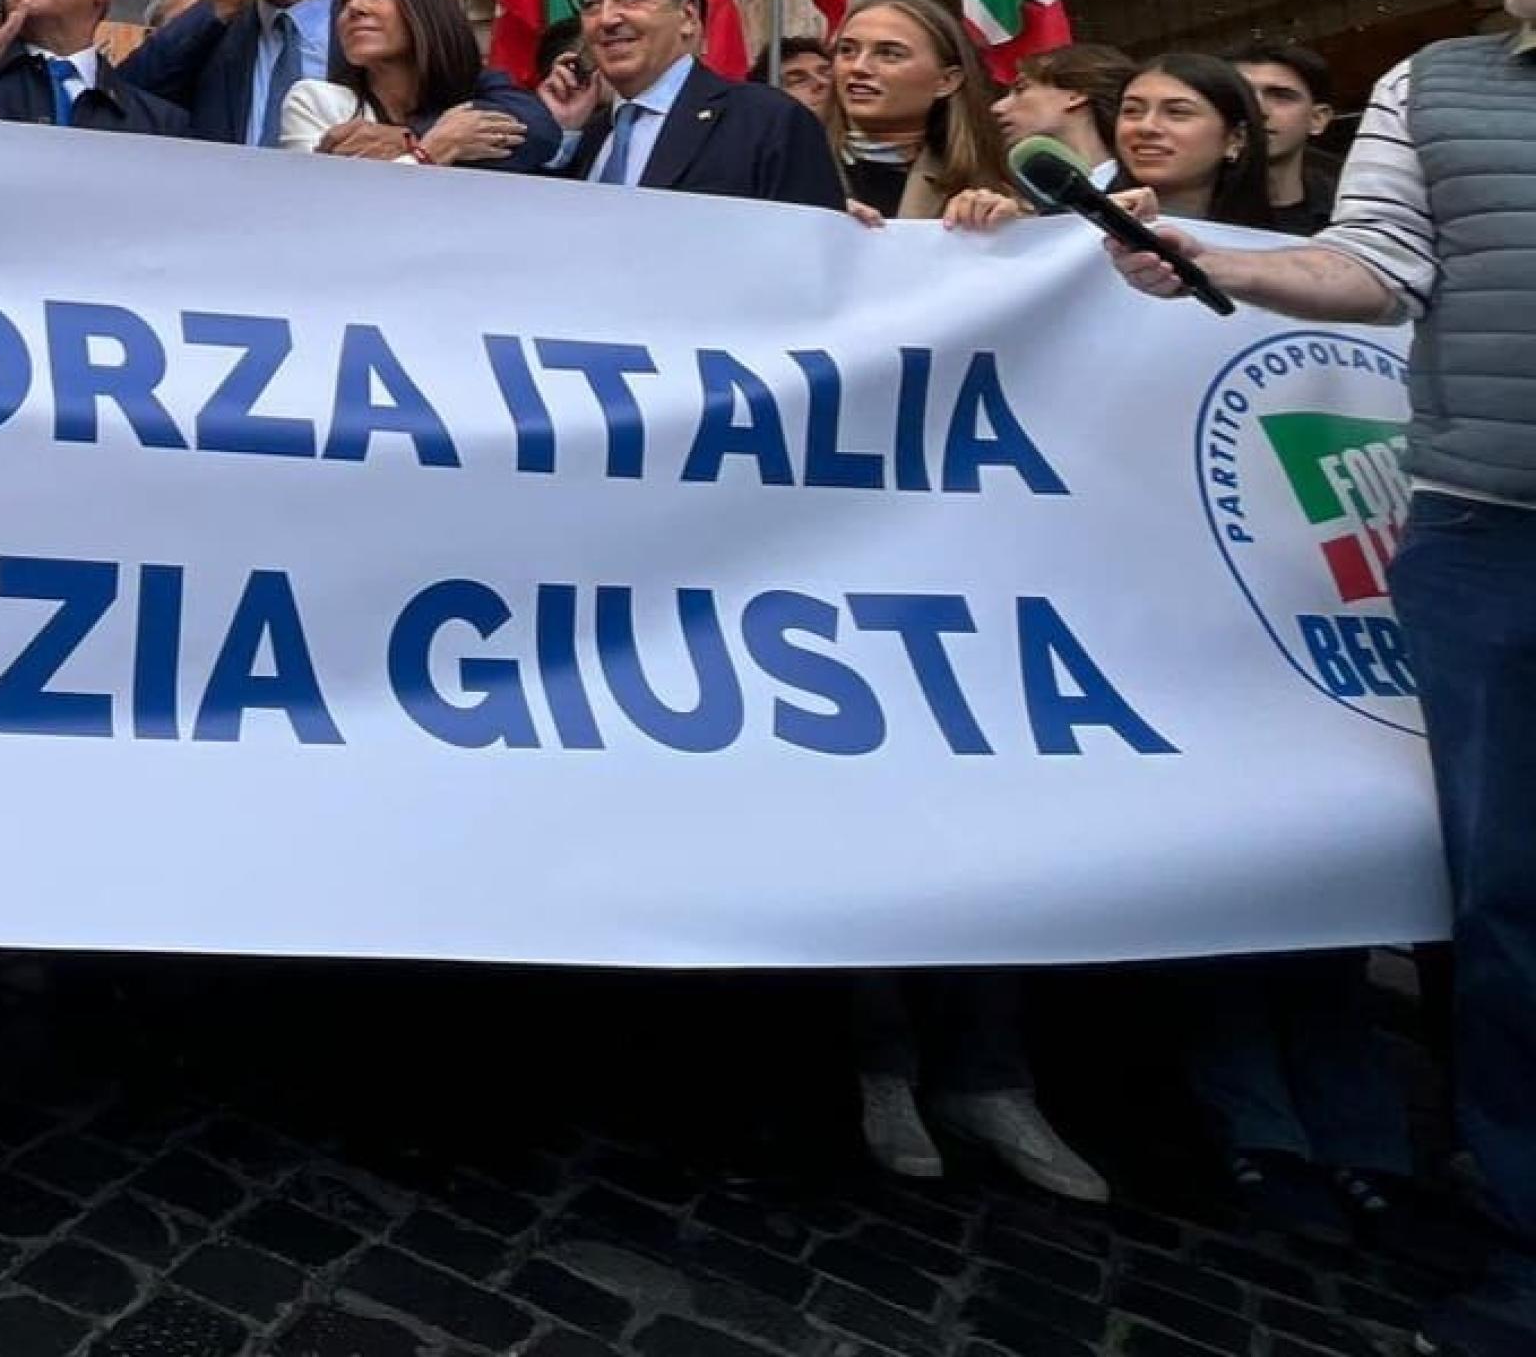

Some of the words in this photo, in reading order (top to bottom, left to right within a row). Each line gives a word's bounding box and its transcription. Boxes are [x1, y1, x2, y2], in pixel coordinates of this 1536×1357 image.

[488, 337, 1071, 496] ITALIA
[1209, 390, 1250, 543] PARTITO
[386, 578, 1181, 756] GIUSTA
